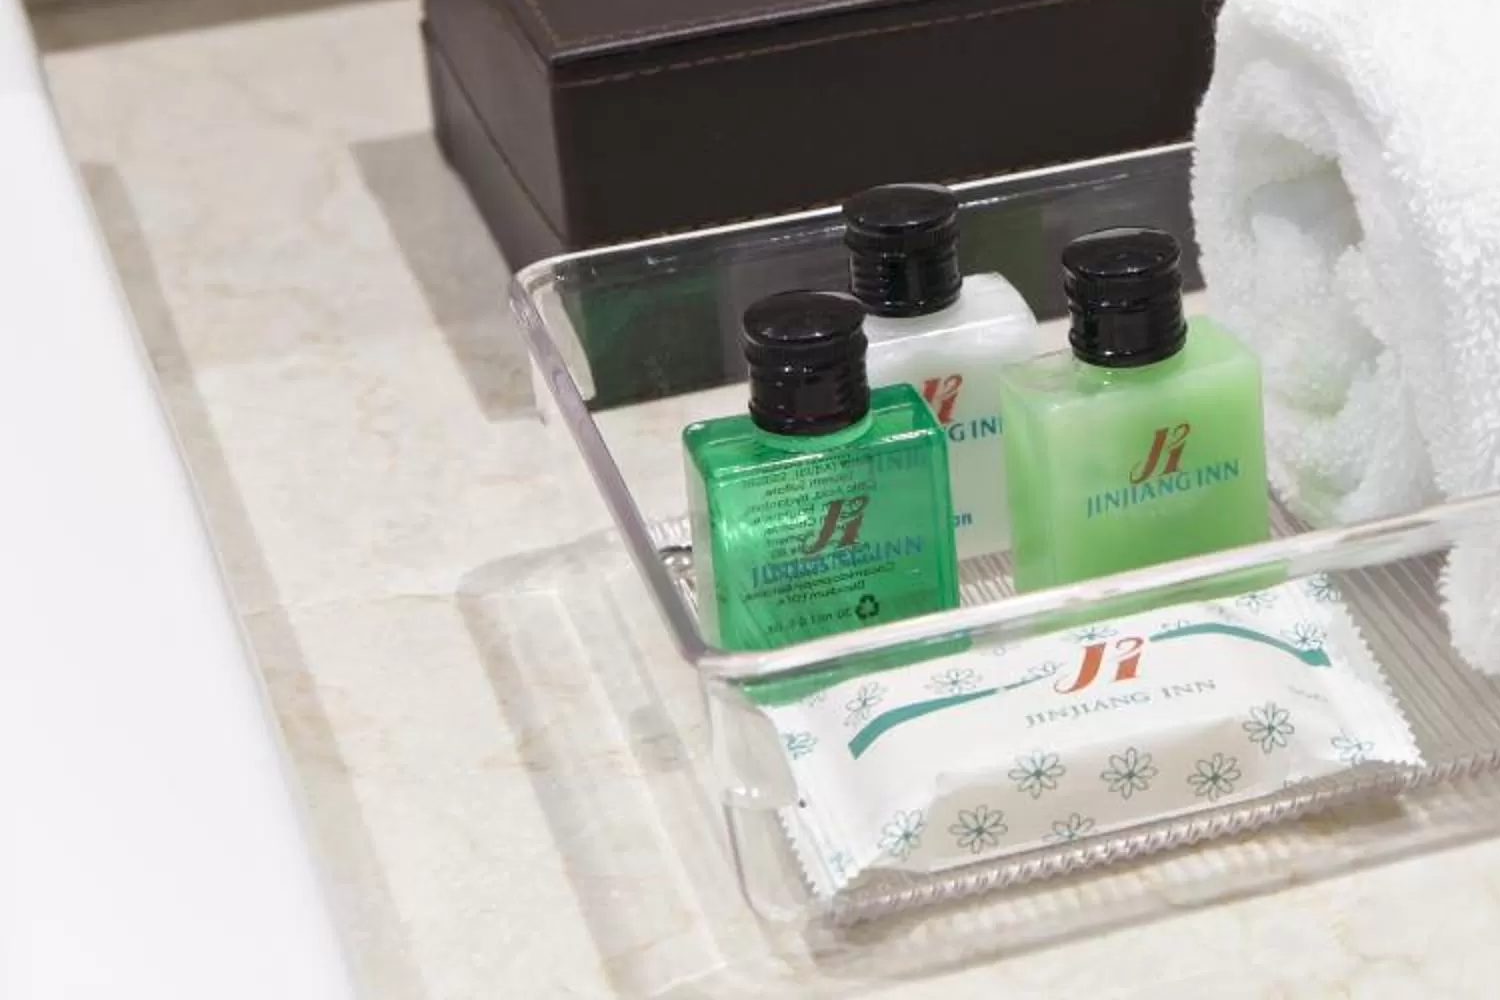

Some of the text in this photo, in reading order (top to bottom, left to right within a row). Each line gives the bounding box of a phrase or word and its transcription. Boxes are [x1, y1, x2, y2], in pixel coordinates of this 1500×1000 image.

[1087, 459, 1240, 519] JINJIANG INN
[1025, 678, 1217, 728] JINJIANG INN
